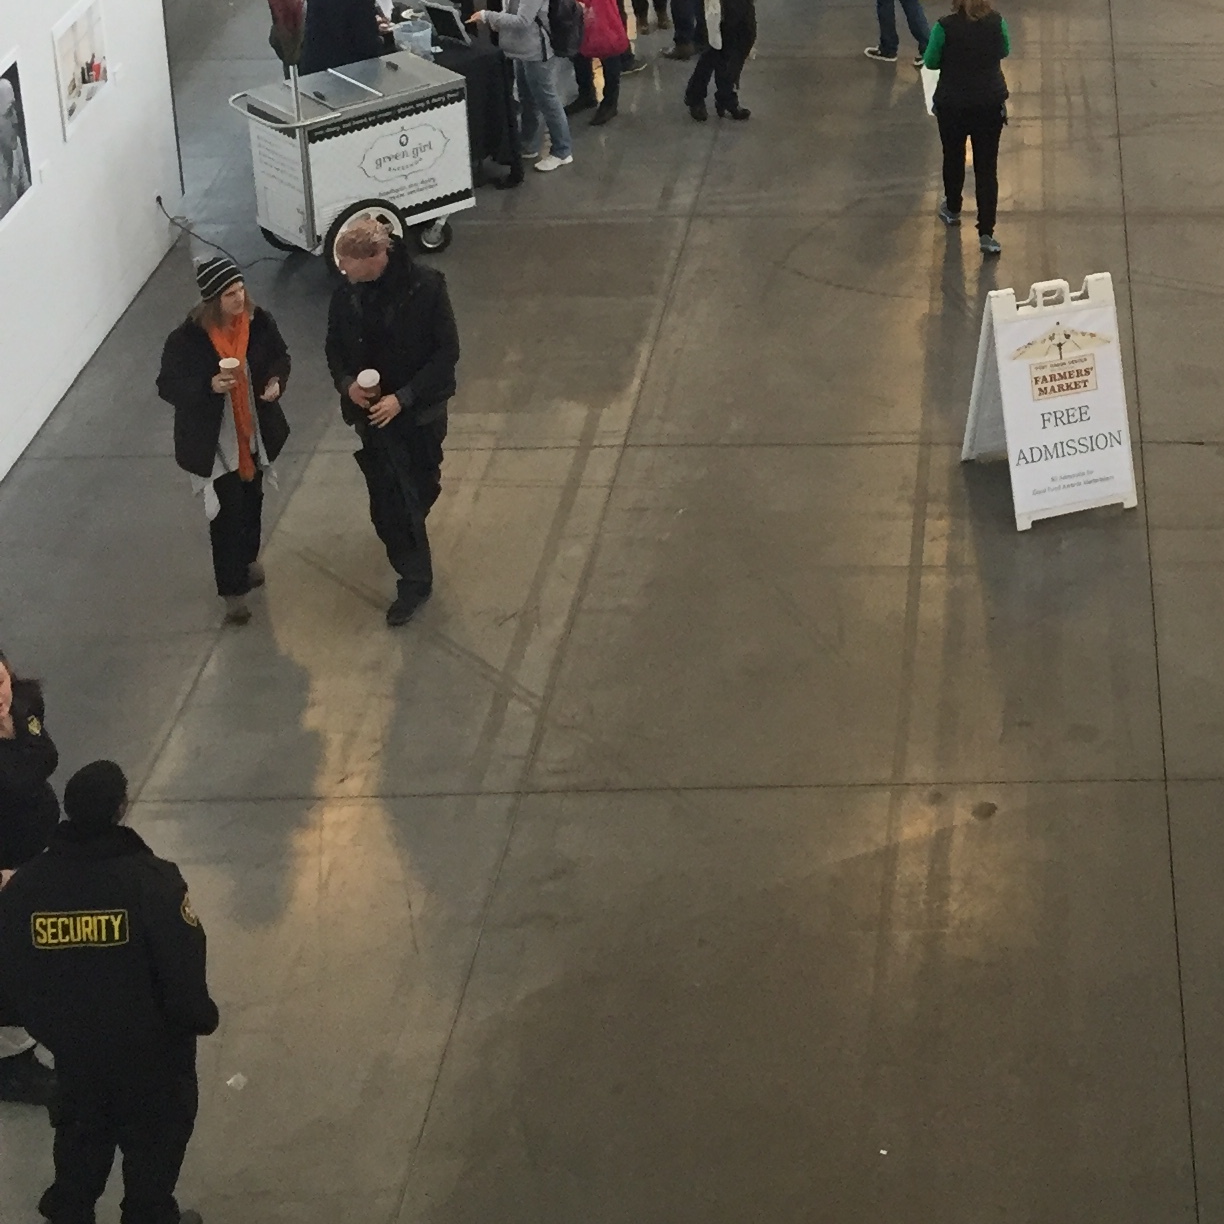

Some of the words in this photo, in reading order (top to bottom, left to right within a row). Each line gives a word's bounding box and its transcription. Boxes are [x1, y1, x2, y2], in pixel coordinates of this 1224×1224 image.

[375, 150, 409, 170] green
[412, 140, 433, 159] girl
[1033, 366, 1094, 386] FARMERS'
[1037, 379, 1089, 397] MARKET
[1040, 404, 1091, 430] FREE
[1015, 429, 1123, 467] ADMISSION
[34, 913, 124, 945] SECURITY
